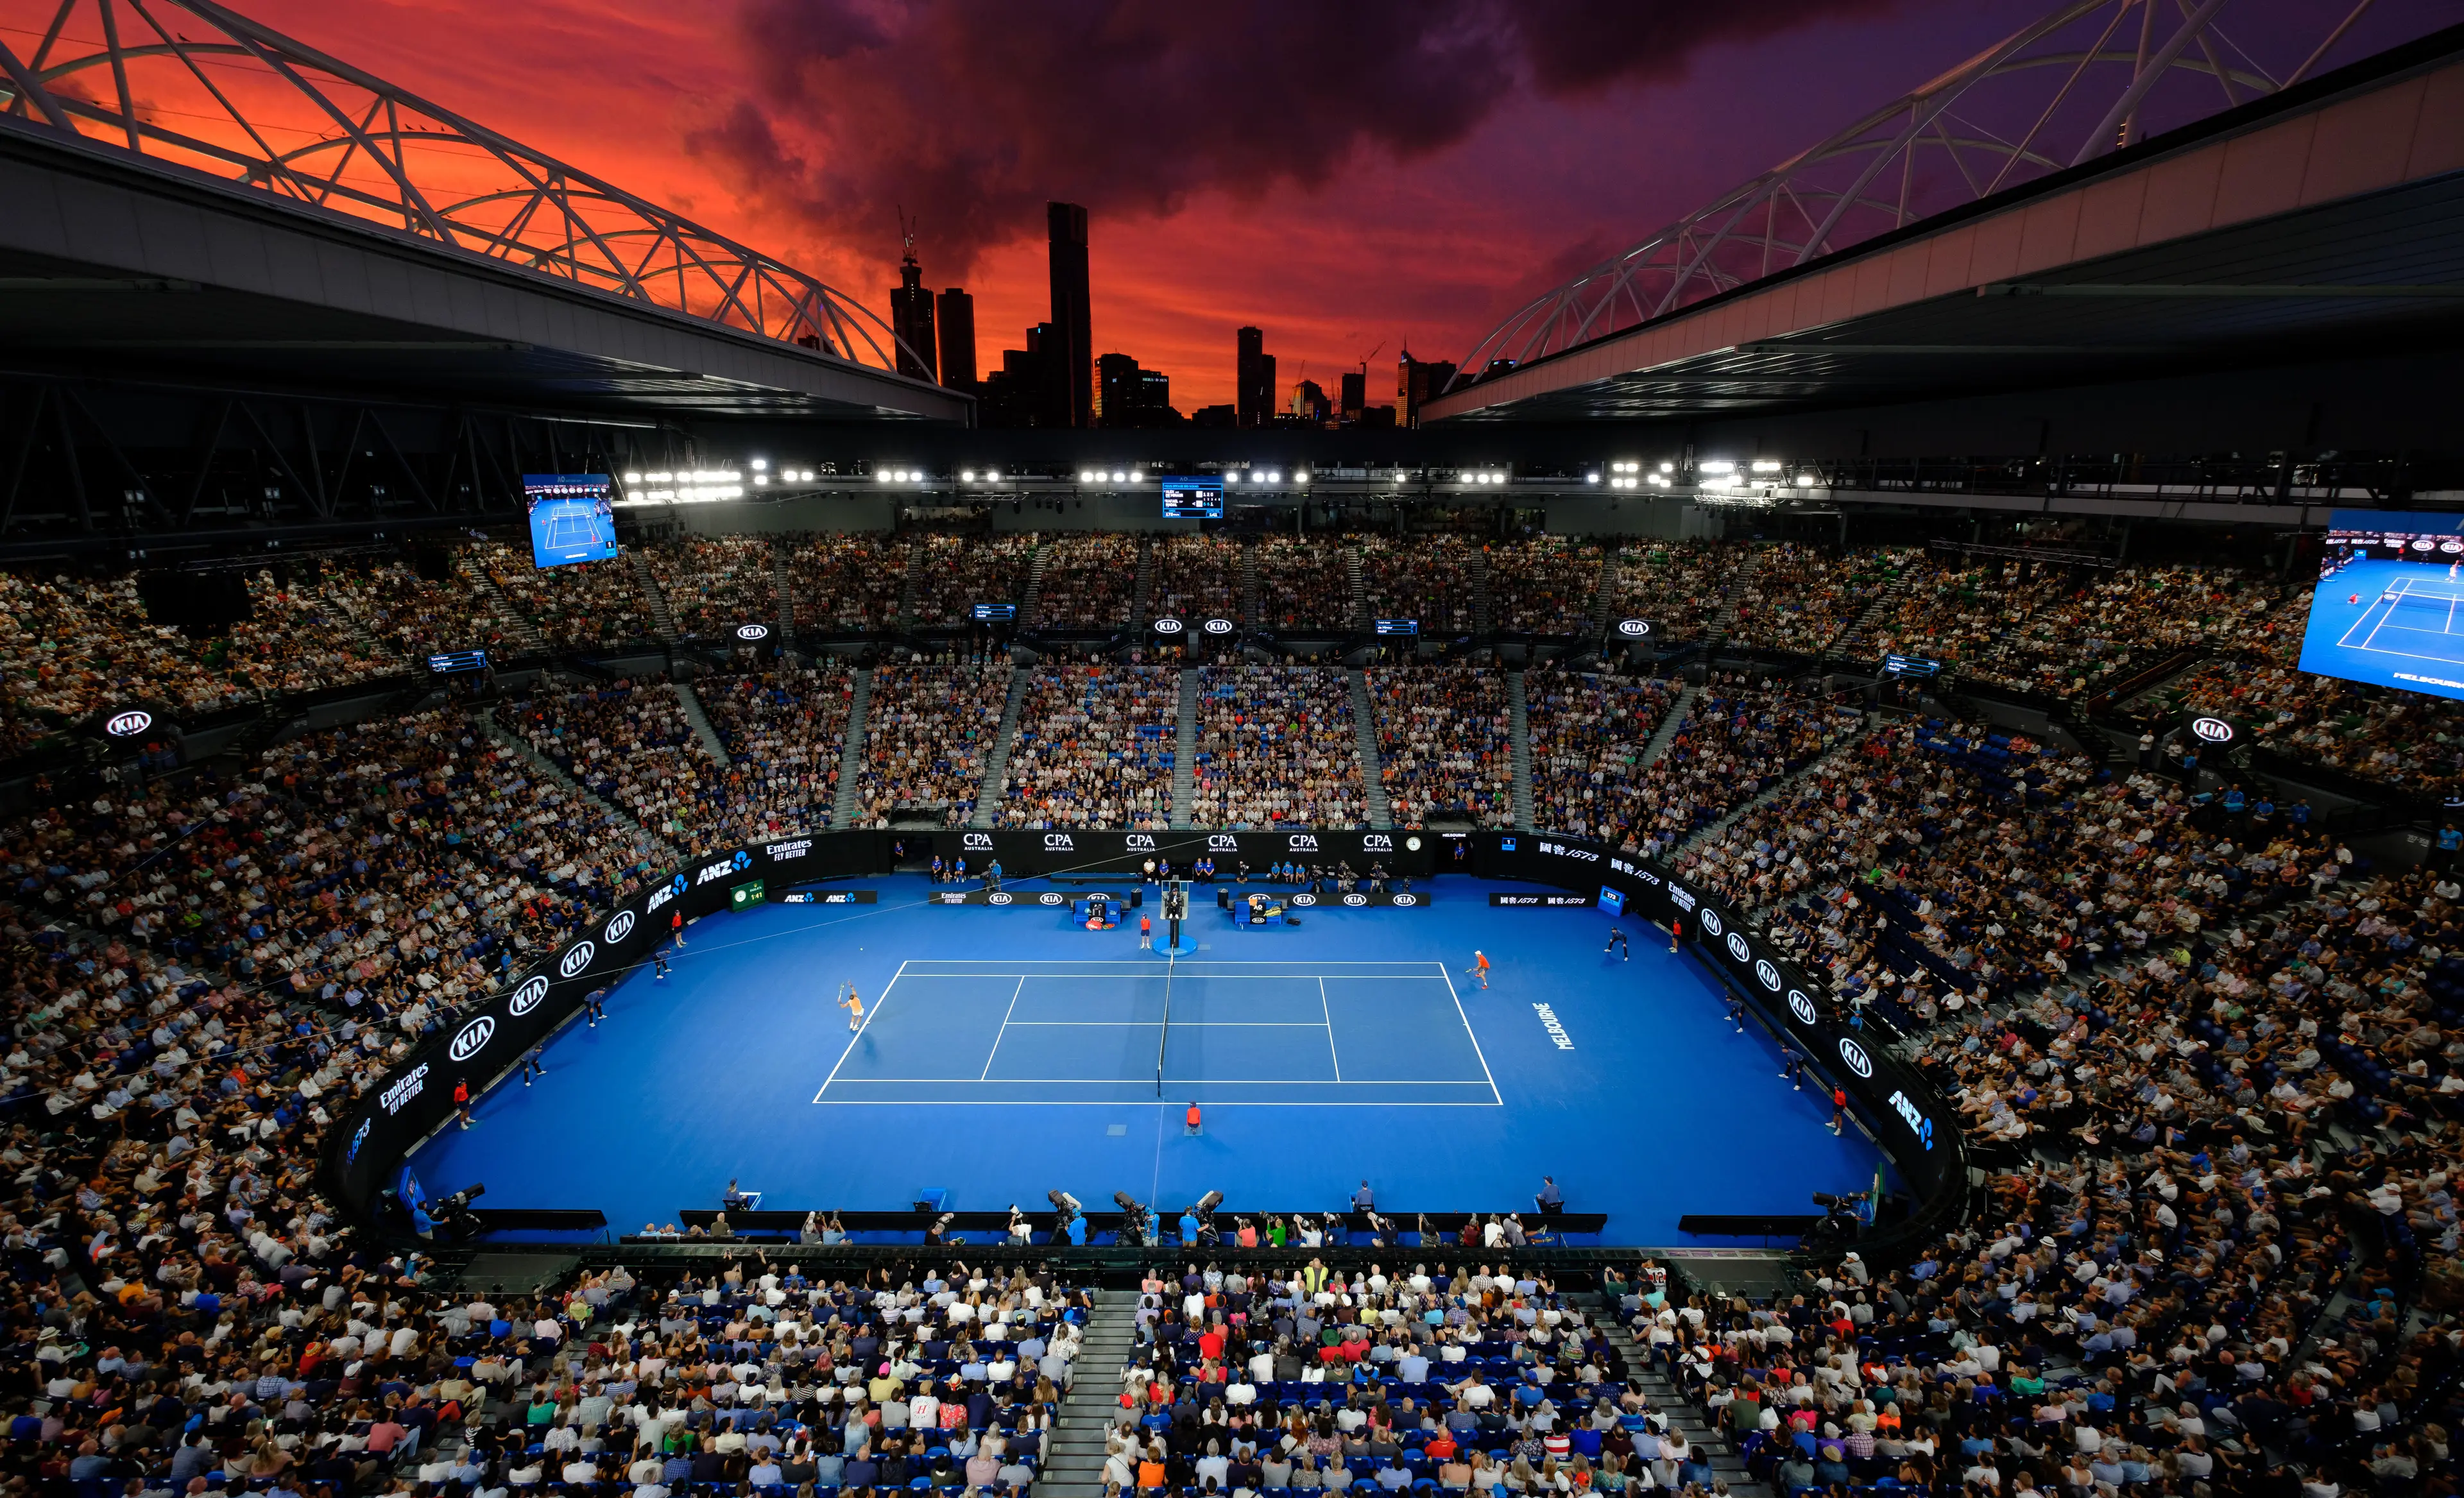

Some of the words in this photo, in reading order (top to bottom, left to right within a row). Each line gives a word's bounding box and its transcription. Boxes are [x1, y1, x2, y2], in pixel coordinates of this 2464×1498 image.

[964, 834, 993, 846] CPA
[1045, 834, 1074, 846] CPA
[1126, 835, 1155, 846] CPA
[1209, 835, 1237, 847] CPA
[1289, 835, 1318, 847] CPA
[1364, 835, 1392, 847] CPA
[767, 840, 812, 855] Emirates
[774, 853, 784, 861] FLY
[785, 849, 806, 859] BETTER
[697, 860, 732, 885] ANZ
[647, 885, 673, 914] ANZ
[751, 892, 762, 900] 1:41
[1668, 881, 1696, 906] Emirates
[1678, 898, 1691, 912] BETTER
[1532, 1003, 1575, 1049] MELBOURNE
[380, 1062, 429, 1109] Emirates
[389, 1097, 399, 1116] FLY
[400, 1080, 424, 1106] BETTER
[1888, 1091, 1922, 1135] ANZ
[1652, 1272, 1664, 1284] 12
[916, 1404, 930, 1414] H
